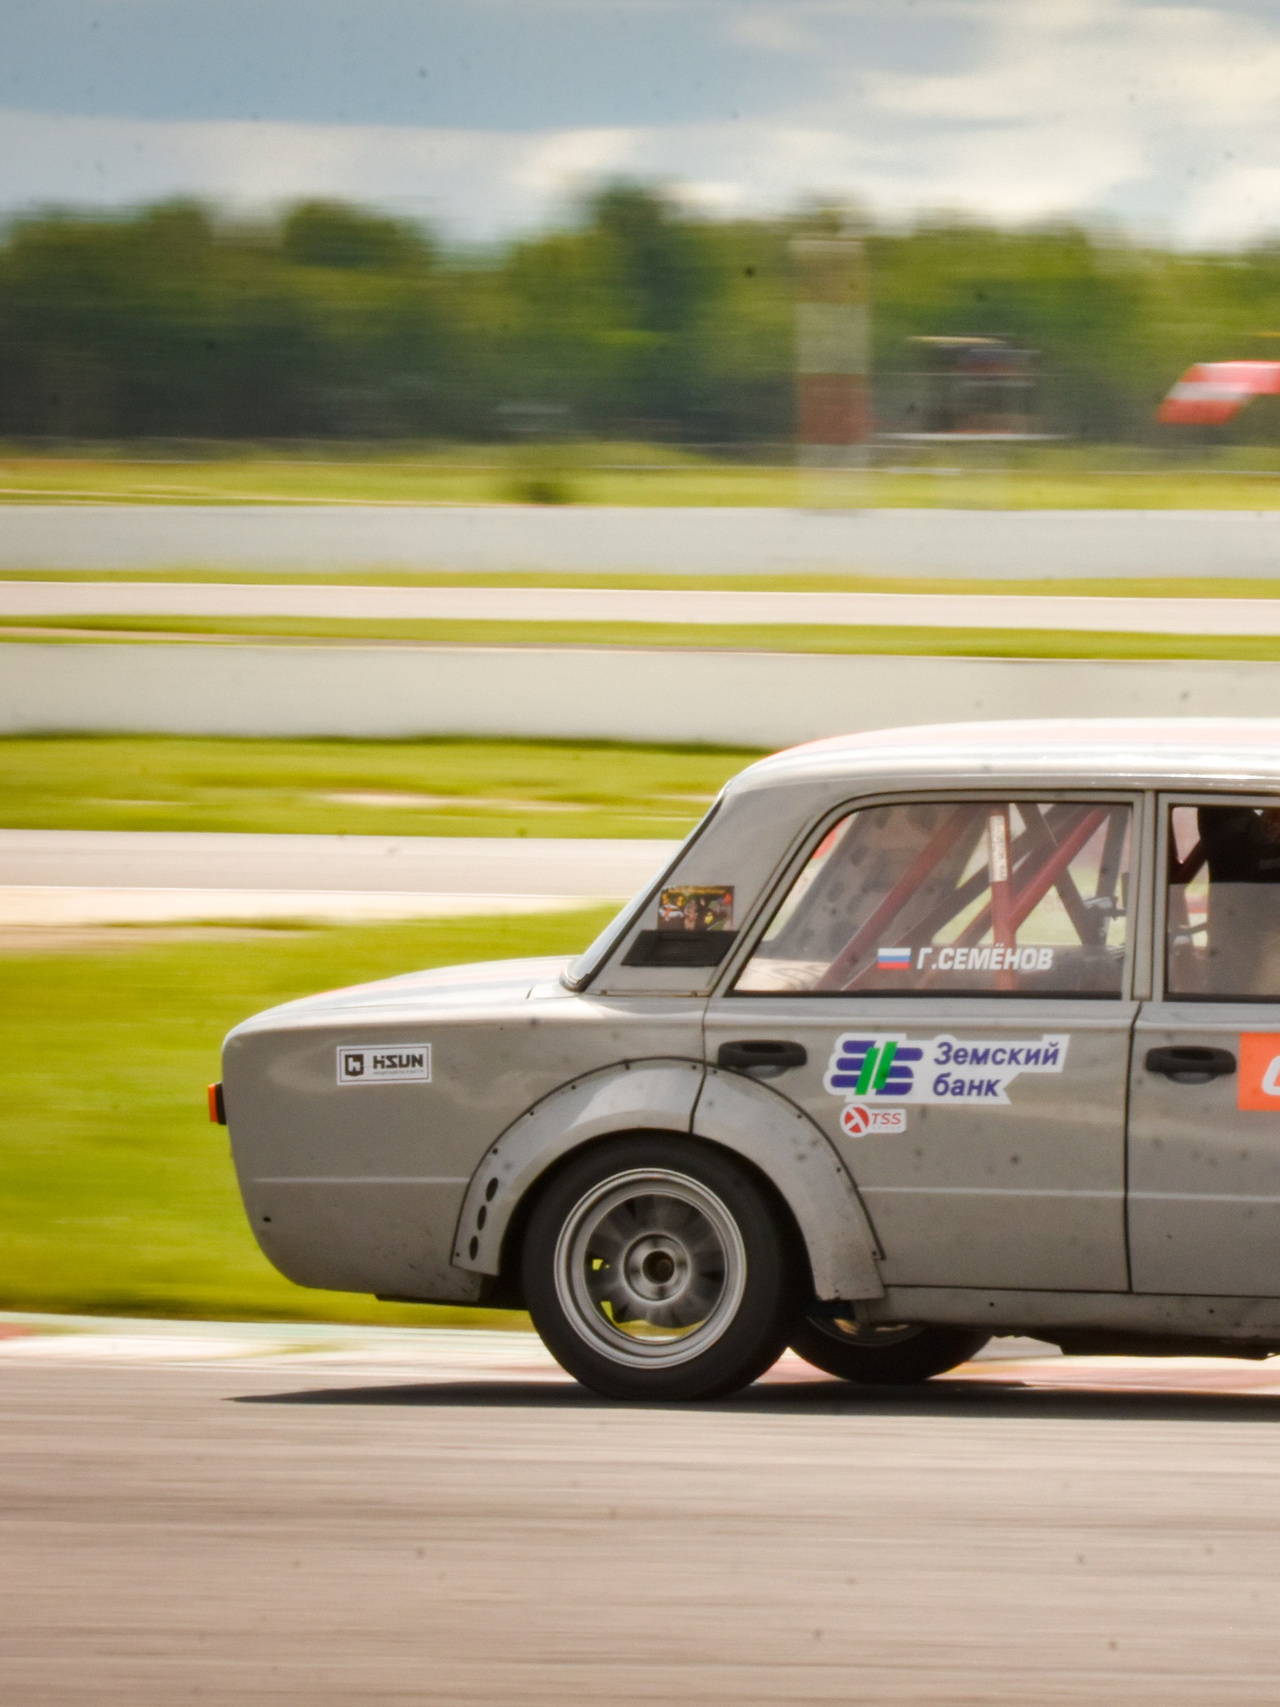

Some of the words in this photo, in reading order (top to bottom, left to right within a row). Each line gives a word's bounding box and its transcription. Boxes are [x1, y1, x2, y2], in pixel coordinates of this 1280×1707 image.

[916, 943, 1054, 970] Г.СЕМЁНОВ
[933, 1041, 1060, 1066] Земский
[932, 1072, 1001, 1097] банк
[871, 1112, 901, 1126] TSS
